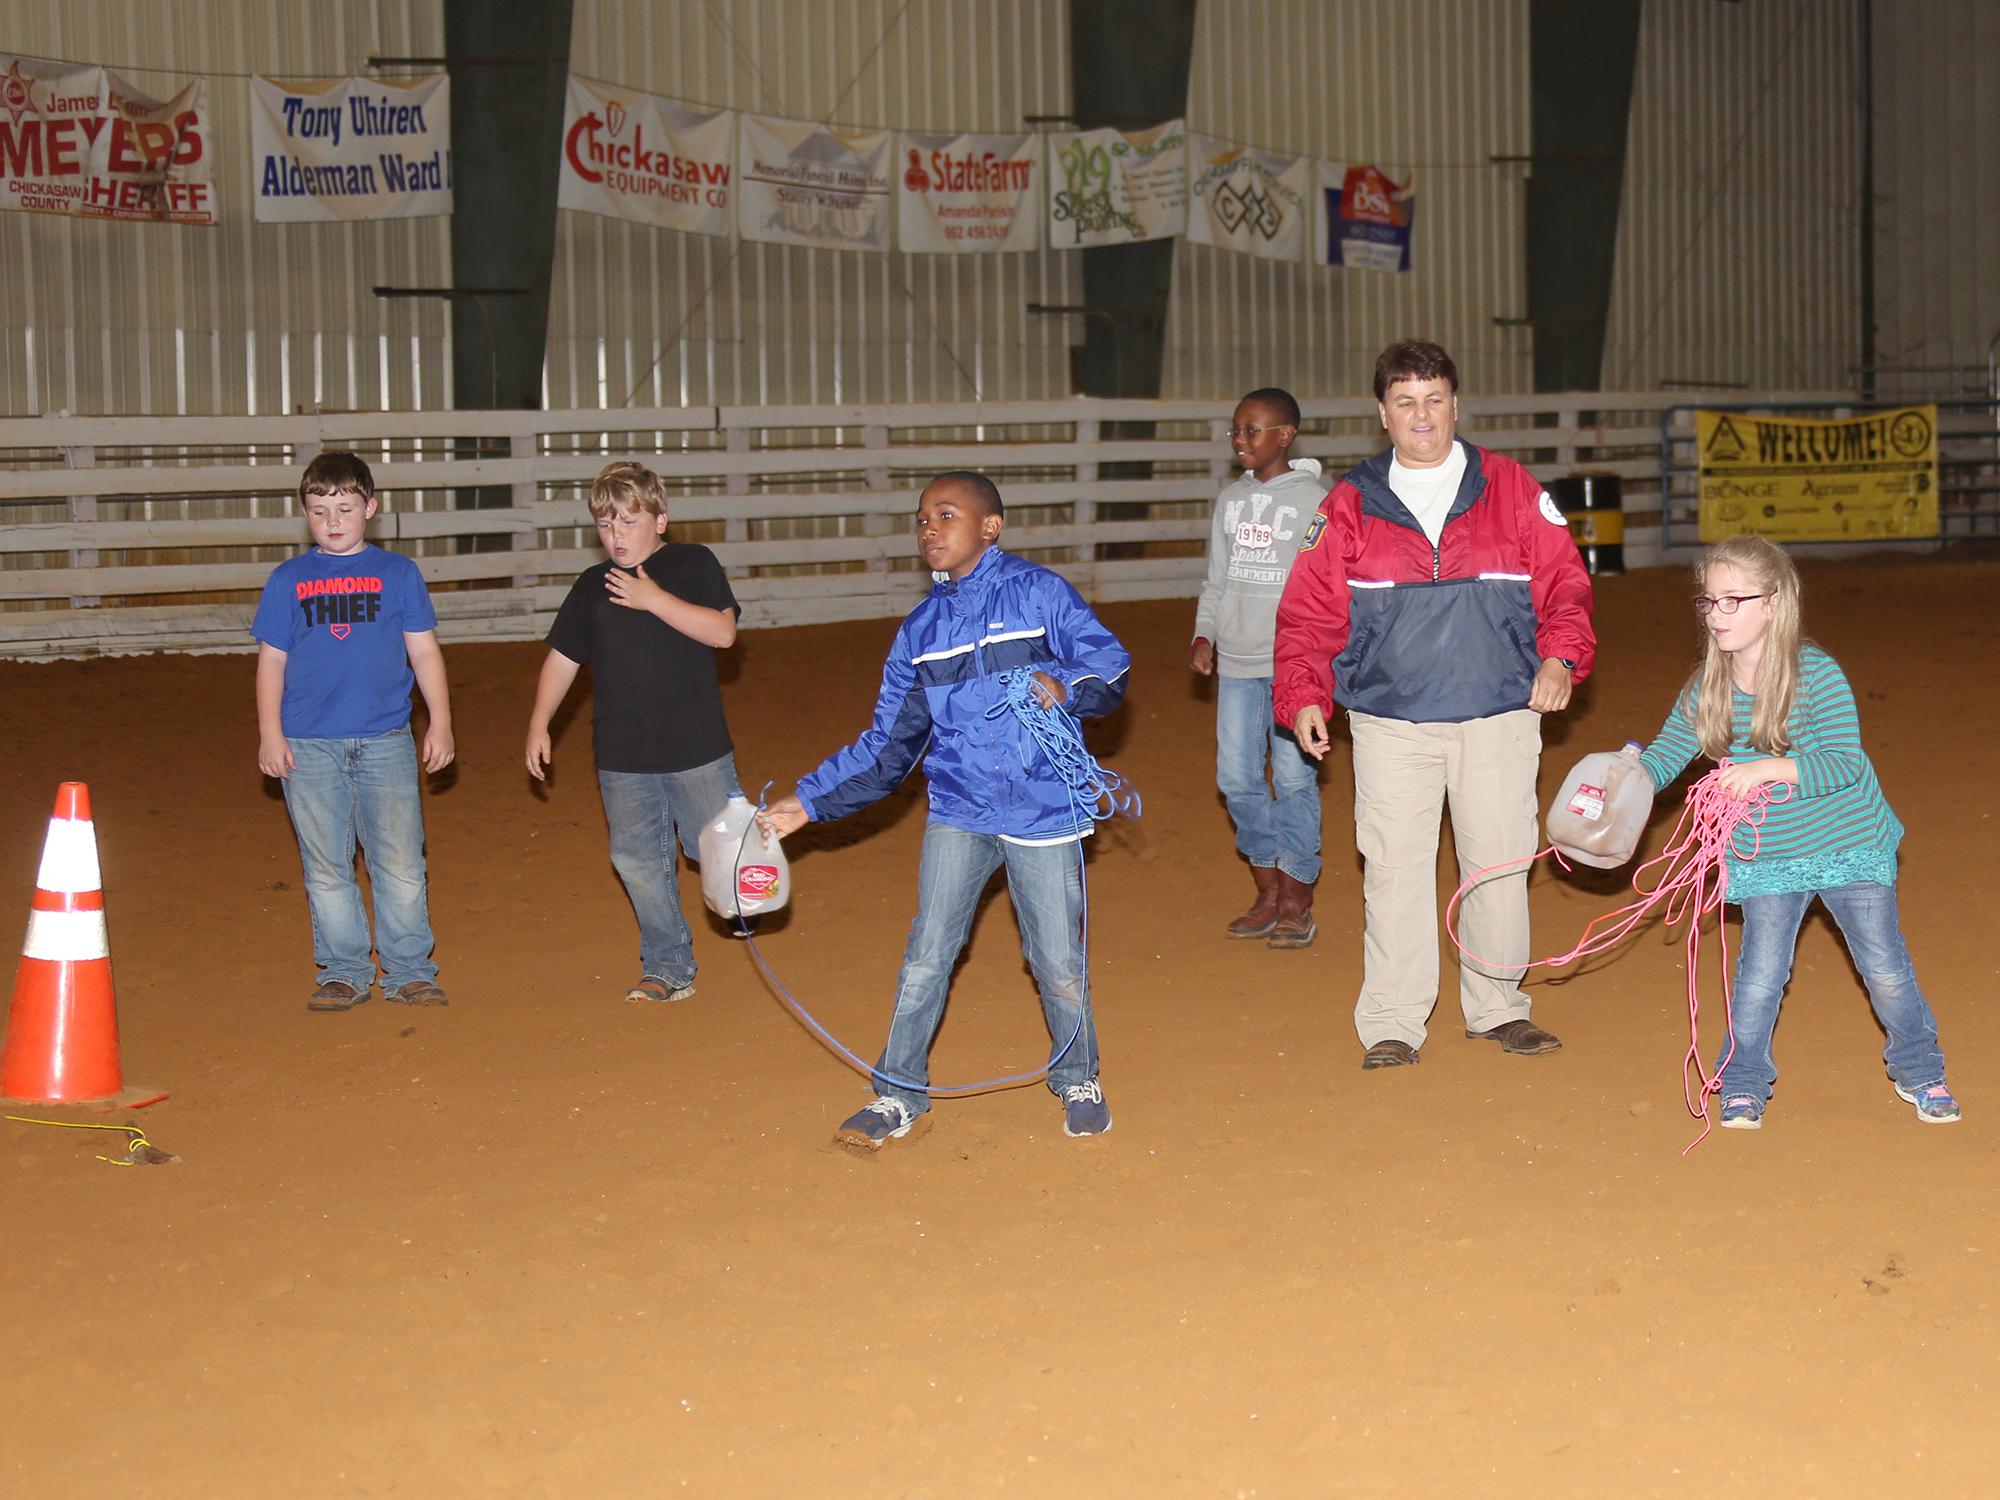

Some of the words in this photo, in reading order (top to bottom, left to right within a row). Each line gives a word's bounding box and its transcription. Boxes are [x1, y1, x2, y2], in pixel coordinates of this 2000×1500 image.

[47, 93, 101, 112] Jame
[282, 97, 341, 146] Tony
[0, 110, 203, 179] MEYERS
[566, 108, 730, 187] Chickasaw
[261, 155, 378, 197] Alderman
[379, 150, 442, 193] Ward
[752, 158, 799, 181] Memorial
[9, 181, 82, 200] CHICKASAW
[21, 196, 70, 211] COUNTY
[606, 170, 699, 205] EQUIPMENT
[1755, 418, 1888, 463] WELCOME!
[295, 575, 384, 600] DIAMOND
[300, 593, 382, 628] THIEF
